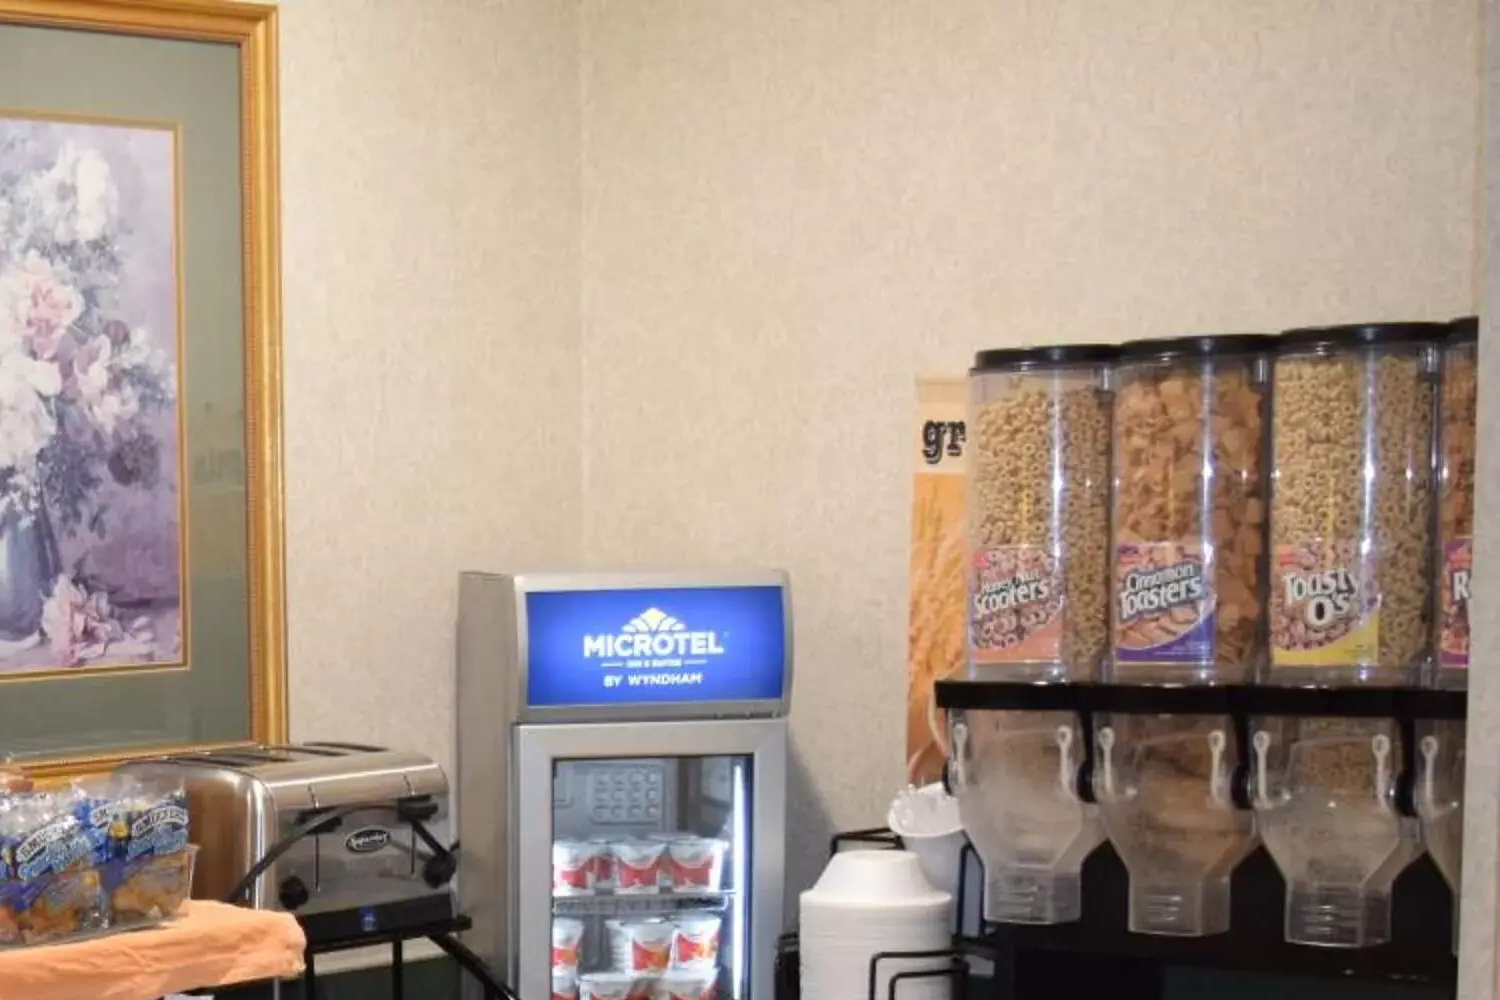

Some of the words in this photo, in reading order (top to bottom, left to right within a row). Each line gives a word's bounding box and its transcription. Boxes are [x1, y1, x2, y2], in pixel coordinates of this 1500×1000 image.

[974, 578, 1050, 620] Scooters
[1120, 576, 1204, 620] Toasters
[1282, 563, 1360, 607] Toasty
[583, 631, 725, 658] MICROTEL
[603, 674, 624, 688] BY
[627, 671, 703, 686] WYNDHAM
